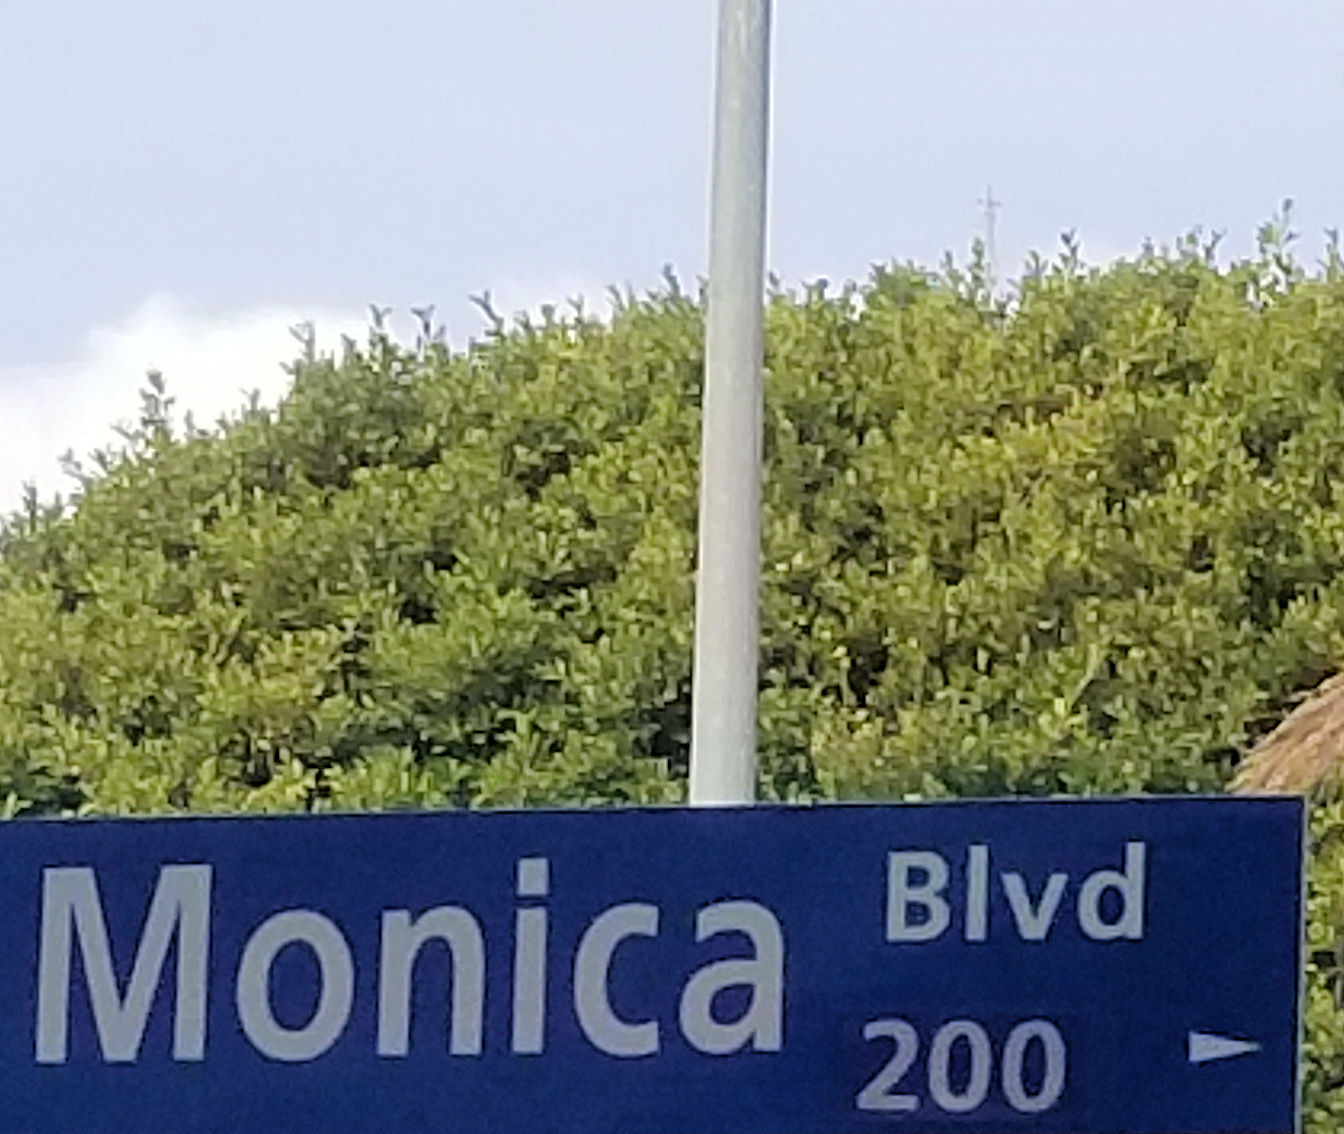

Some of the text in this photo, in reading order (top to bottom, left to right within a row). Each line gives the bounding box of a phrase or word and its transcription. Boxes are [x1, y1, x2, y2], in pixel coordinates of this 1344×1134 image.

[35, 857, 784, 1064] Monica
[886, 841, 1146, 942] Blvd
[857, 1019, 1066, 1113] 200
